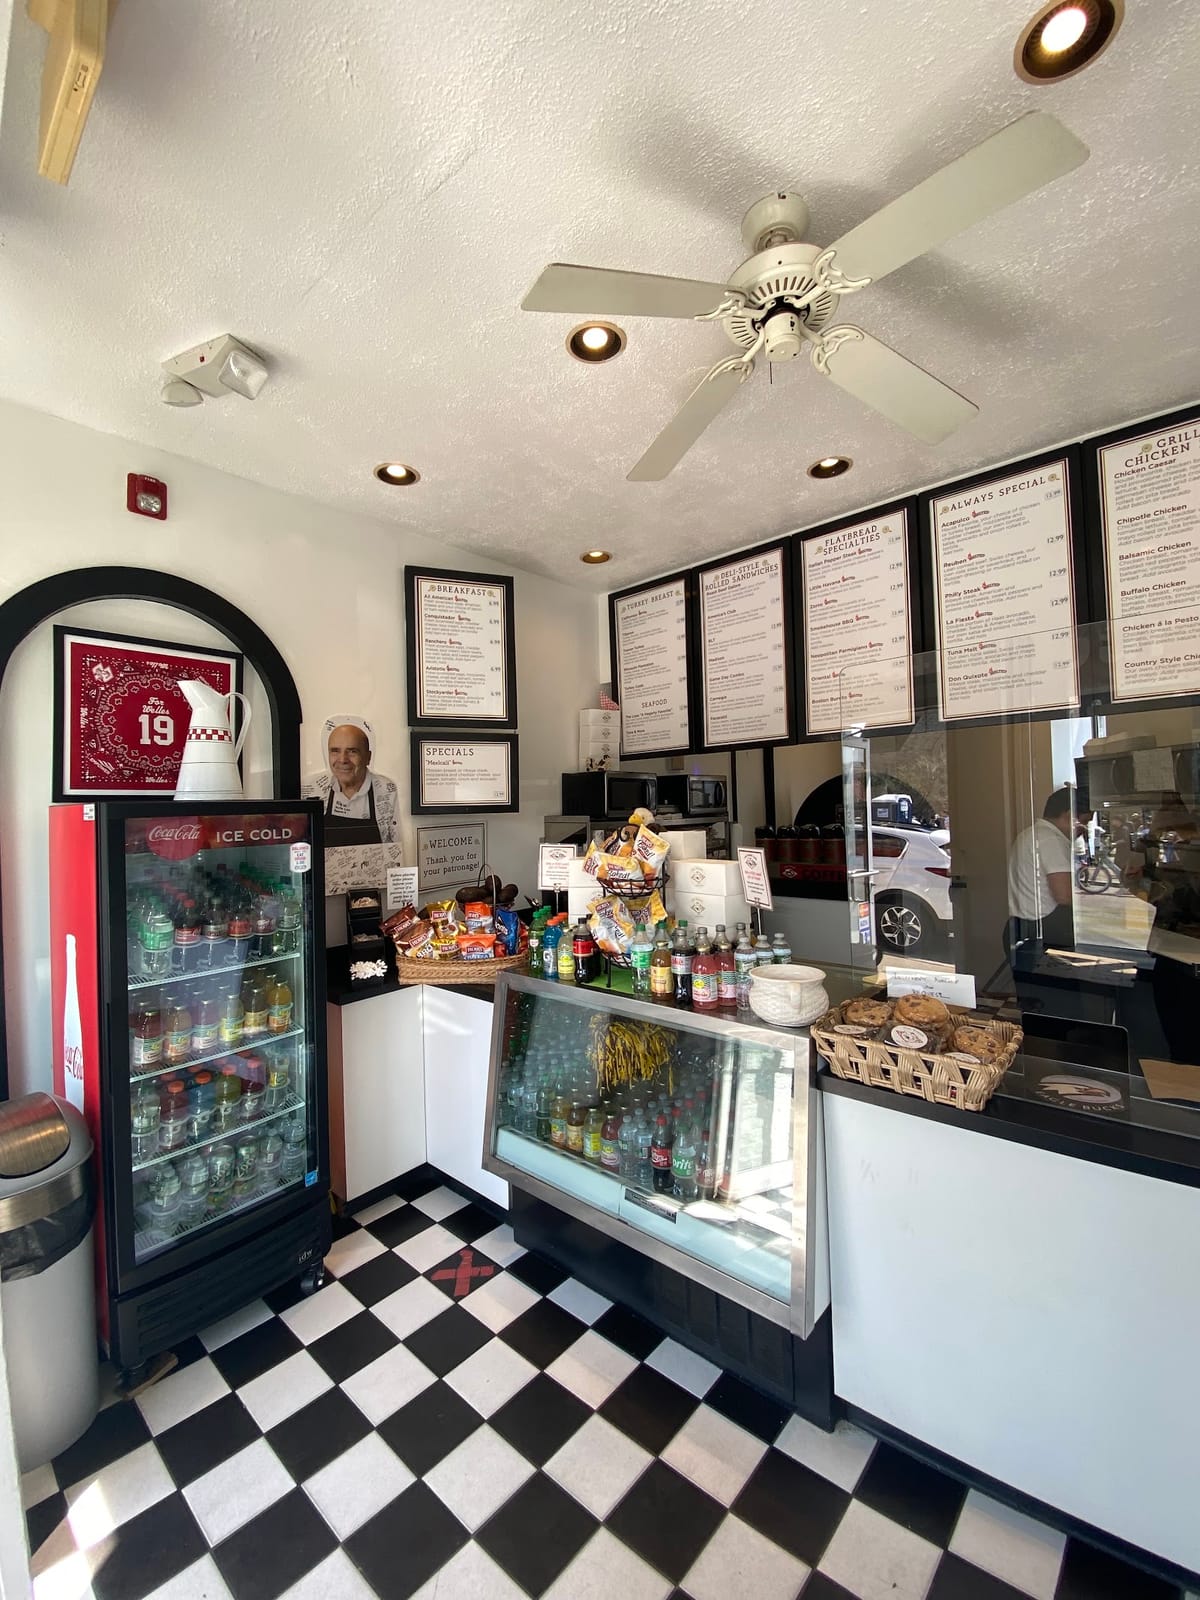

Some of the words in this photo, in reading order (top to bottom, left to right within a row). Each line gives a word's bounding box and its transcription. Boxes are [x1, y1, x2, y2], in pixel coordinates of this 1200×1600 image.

[1125, 443, 1190, 468] CHICKEN
[1114, 467, 1146, 479] Chicken
[1148, 458, 1177, 470] Caesar
[950, 492, 994, 512] ALWAYS
[999, 477, 1046, 497] SPECIAL
[1117, 513, 1151, 525] Chipotle
[1153, 504, 1187, 517] Chicken
[941, 516, 970, 529] Acapulco
[825, 525, 878, 547] FLATBREAD
[1047, 535, 1064, 544] 12.99
[823, 532, 881, 556] SPECIALTIES
[1119, 549, 1155, 561] Balsamic
[1157, 541, 1191, 553] Chicken
[943, 558, 967, 568] Reuben
[720, 561, 760, 580] DELI-STYLE
[1049, 568, 1066, 577] 12.99
[705, 578, 730, 592] ROLLED
[731, 563, 779, 584] SANDWICHES
[822, 579, 841, 588] Havana
[437, 585, 486, 596] BREAKFAST
[1120, 587, 1150, 597] Buffalo
[1152, 580, 1186, 591] Chicken
[626, 598, 648, 611] TURKEY
[651, 590, 674, 603] BREAST
[1051, 597, 1068, 607] 12.99
[424, 613, 455, 621] Conquistador
[955, 616, 974, 624] Fiesta
[810, 621, 842, 632] Smokehouse
[842, 618, 854, 626] BBQ
[1122, 623, 1155, 632] Chicken
[1174, 616, 1199, 624] Pesto
[1052, 632, 1069, 640] 12.99
[1124, 660, 1157, 669] Country
[1159, 656, 1181, 664] Style
[962, 672, 988, 681] Quixote
[147, 697, 164, 705] For
[641, 698, 668, 709] SEAFOOD
[811, 697, 829, 705] Boston
[142, 704, 170, 715] Welles
[138, 714, 174, 745] 19
[426, 748, 474, 756] SPECIALS
[149, 824, 202, 841] Coca-Cola
[216, 830, 244, 843] ICE
[250, 828, 292, 841] COLD
[429, 836, 473, 849] WELCOME
[426, 856, 448, 865] Thank
[451, 855, 464, 863] you
[466, 852, 477, 860] for
[423, 868, 440, 878] your
[443, 862, 480, 875] patronage!
